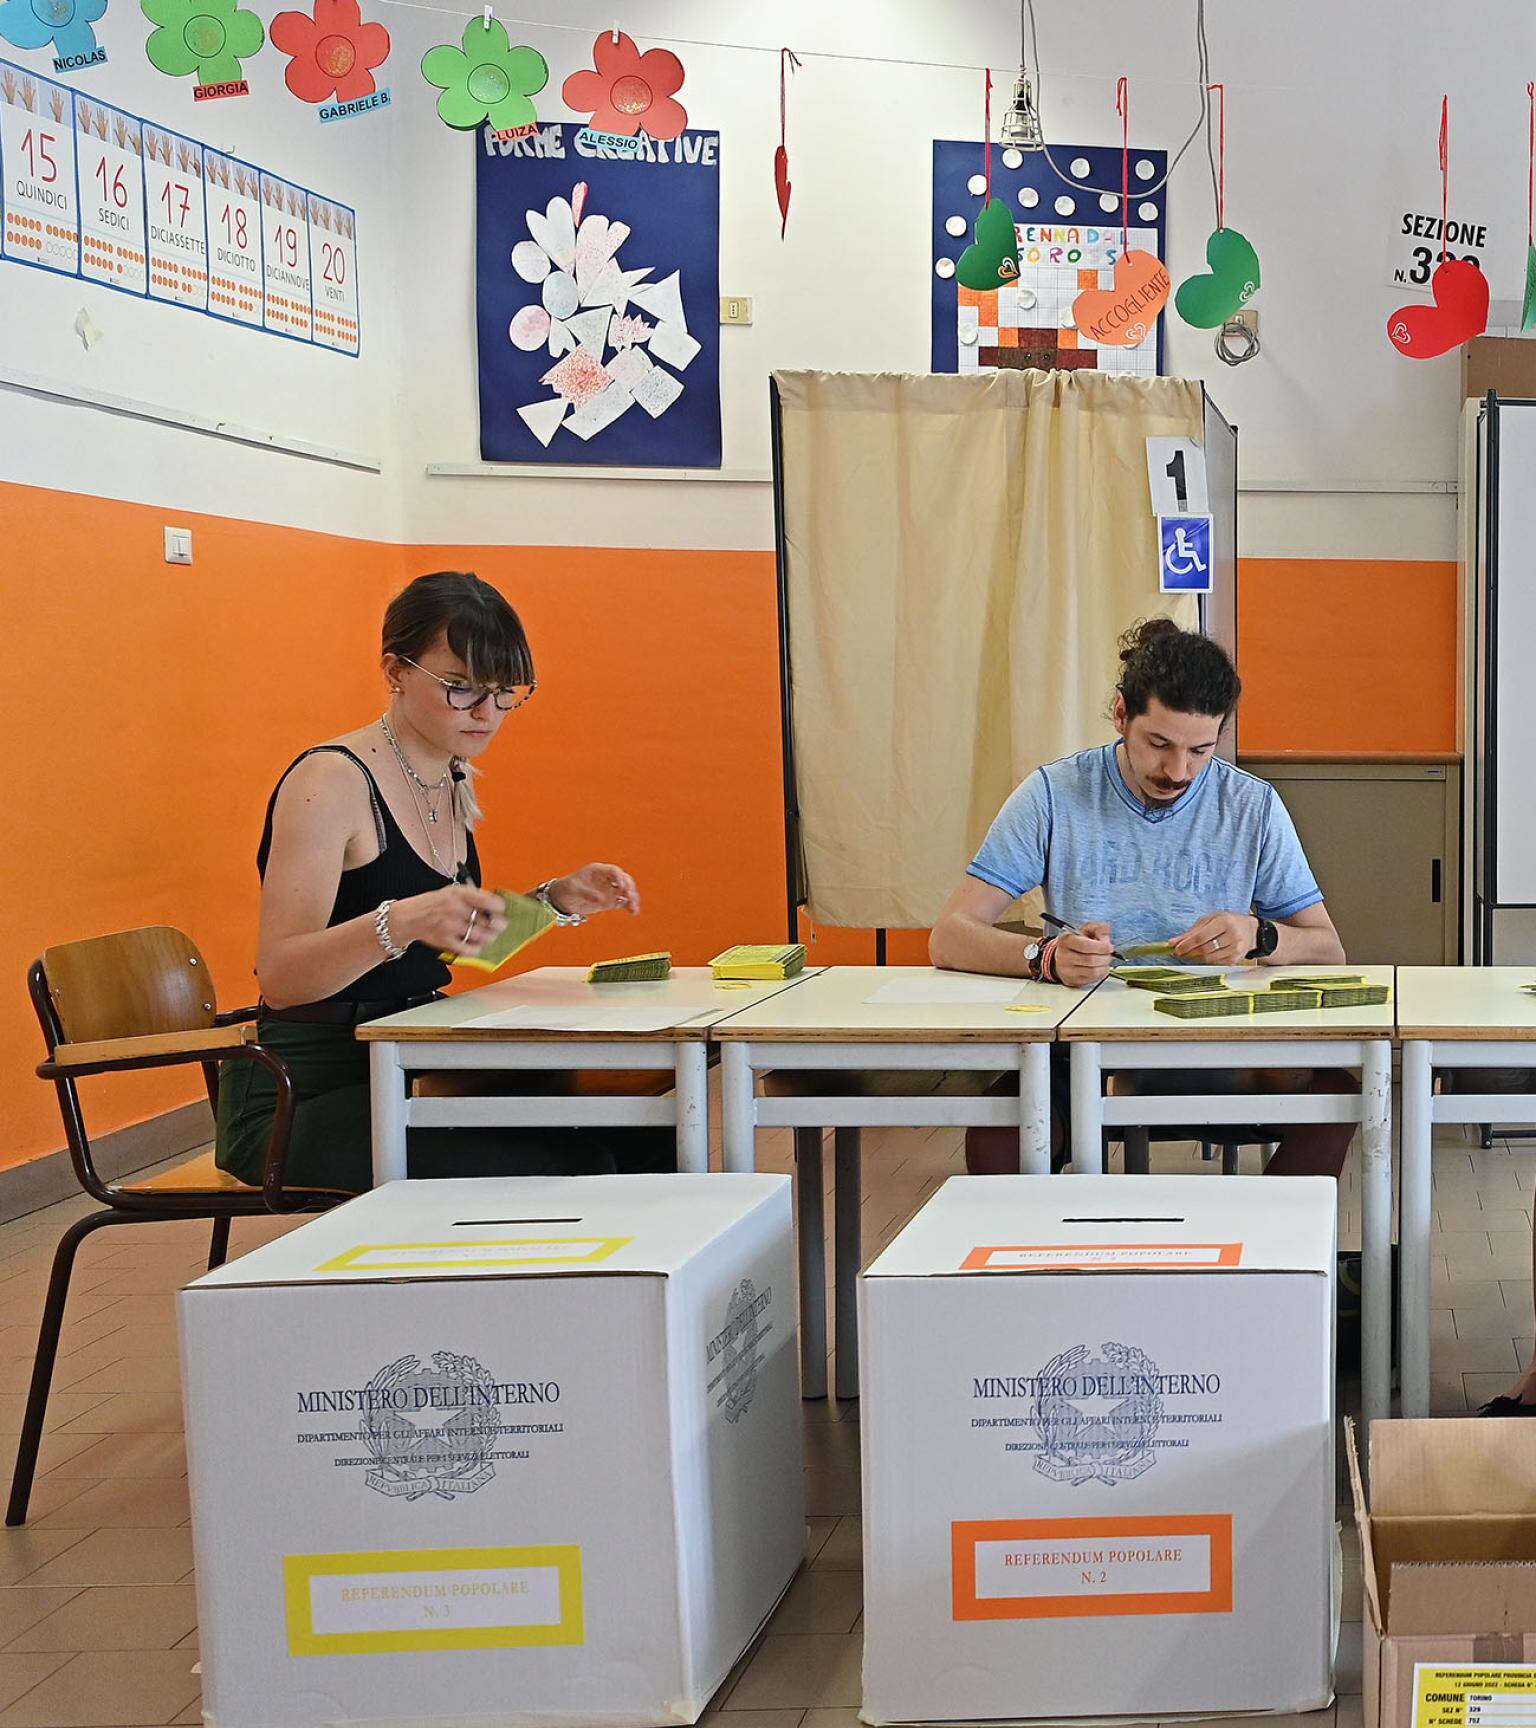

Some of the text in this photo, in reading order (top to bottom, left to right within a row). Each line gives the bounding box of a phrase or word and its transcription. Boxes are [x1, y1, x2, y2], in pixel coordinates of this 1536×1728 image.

[54, 50, 106, 70] NICOLAS
[194, 83, 248, 99] GIORGIA
[320, 93, 391, 119] GABRIELE B.
[497, 125, 537, 142] LUIZA
[579, 132, 638, 149] ALESSIO
[21, 129, 57, 182] 15
[96, 156, 128, 208] 16
[16, 180, 67, 210] QUINDICI
[161, 181, 190, 227] 17
[99, 208, 129, 231] SEDICI
[221, 204, 248, 249] 18
[1401, 213, 1487, 248] SEZIONE
[151, 225, 206, 255] DICIASSETTE
[275, 225, 297, 267] 19
[217, 247, 256, 272] DICIOTTO
[322, 243, 345, 284] 20
[266, 264, 310, 292] DICIANNOVE
[1394, 269, 1407, 282] N.
[325, 286, 345, 302] VENTI
[1090, 268, 1170, 340] ACCOGLIENTE
[1166, 450, 1188, 511] 1
[297, 1382, 560, 1412] MINISTERO DELL'INTERNO
[973, 1373, 1220, 1398] MINISTERO DELL'INTERNO
[499, 1423, 564, 1434] TERRITORIALI
[1161, 1413, 1222, 1423] TERRITORIALI
[1005, 1549, 1182, 1566] REFERENDUM POPOLARE
[1081, 1571, 1107, 1584] N. 2
[341, 1581, 529, 1601] REFERENDUM POPOLARE
[424, 1606, 439, 1617] N.
[1426, 1693, 1465, 1702] COMUNE
